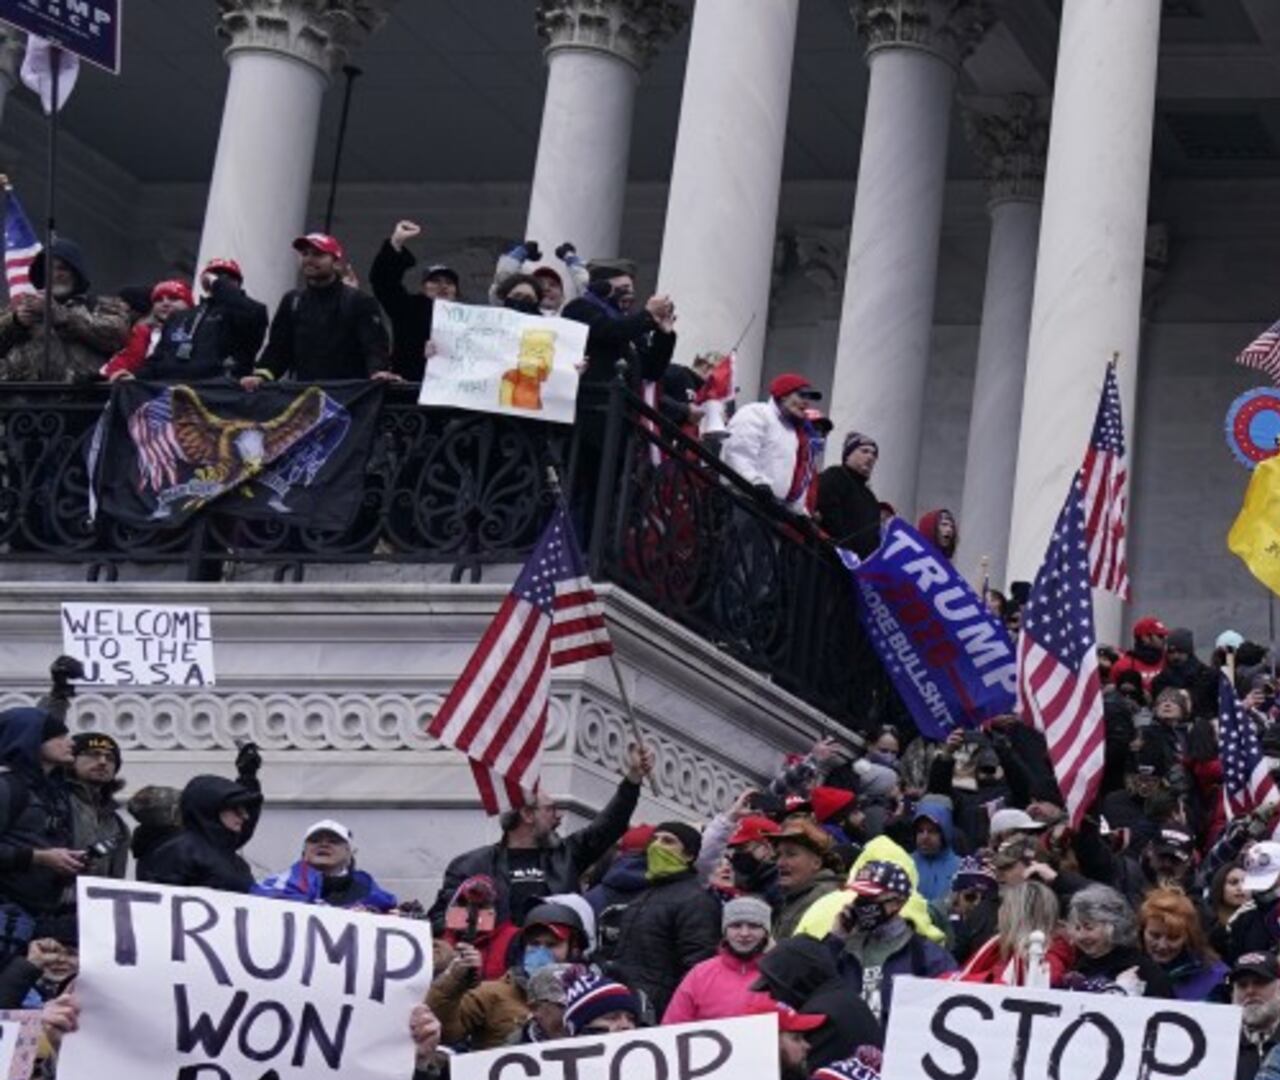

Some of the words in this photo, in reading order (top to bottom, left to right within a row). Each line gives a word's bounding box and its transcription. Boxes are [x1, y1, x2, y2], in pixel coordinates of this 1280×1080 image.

[63, 608, 211, 641] WELCOME
[74, 637, 120, 659] TO
[136, 638, 197, 662] THE
[883, 529, 1016, 693] TRUMP
[888, 632, 954, 728] BULLSHIT
[86, 886, 424, 1002] TRUMP
[174, 984, 353, 1069] WON
